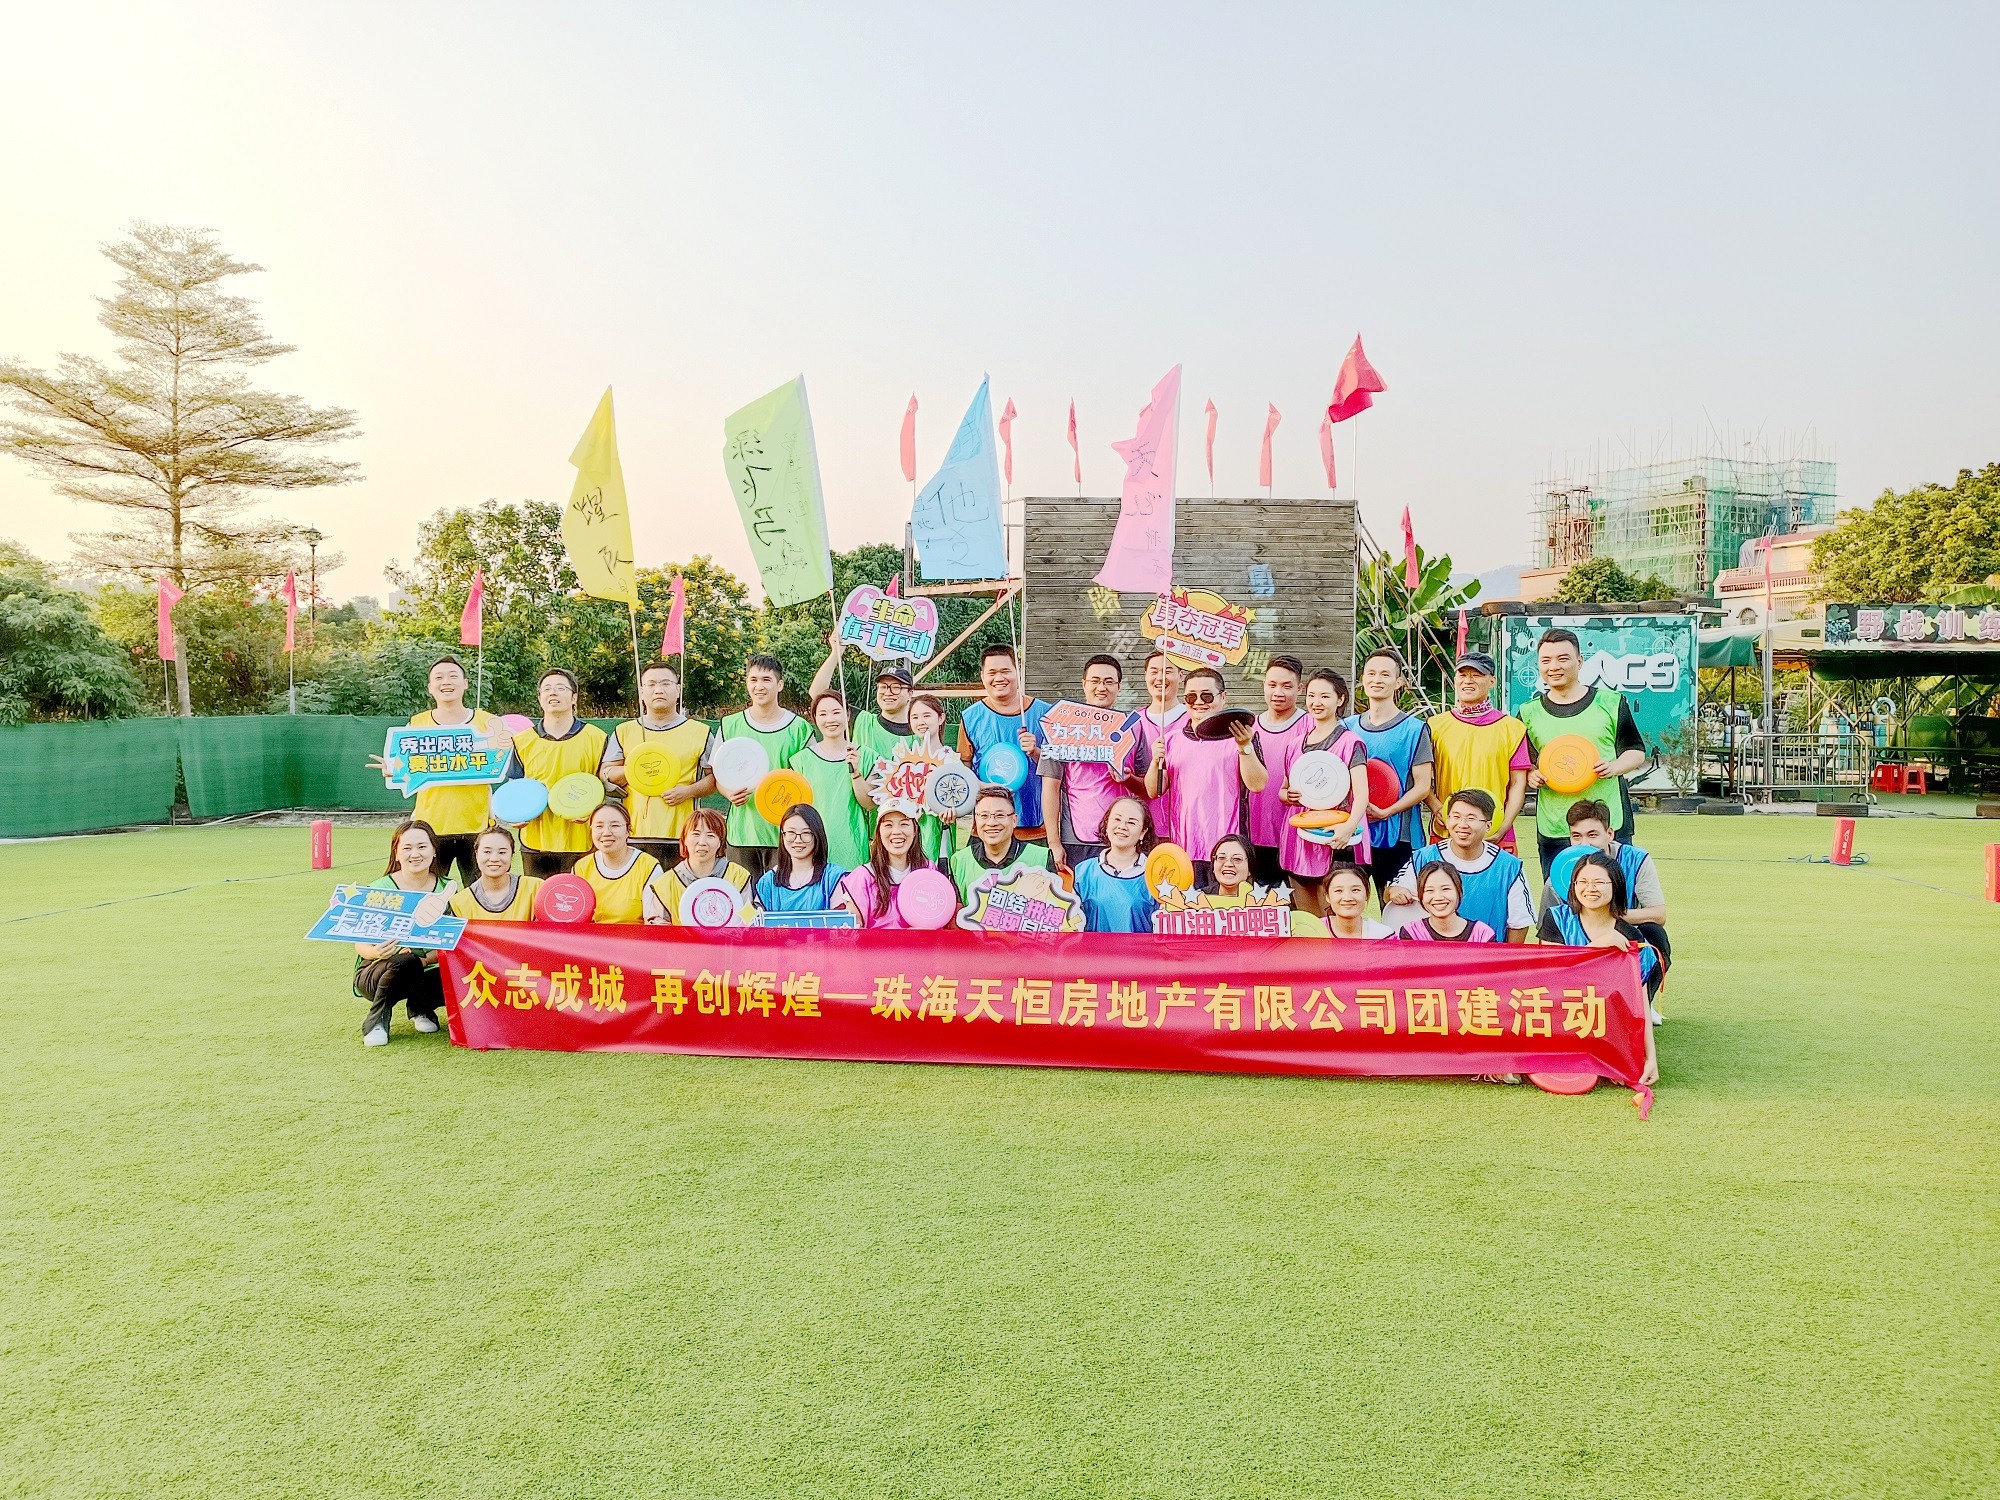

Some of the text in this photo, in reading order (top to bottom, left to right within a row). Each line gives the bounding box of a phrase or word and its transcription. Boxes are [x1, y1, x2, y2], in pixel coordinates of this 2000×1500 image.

[868, 599, 916, 627] 生命
[1156, 599, 1243, 645] 勇夺冠军
[1856, 609, 2000, 641] 野战训练
[841, 613, 932, 659] 在于运动
[1179, 643, 1203, 659] 加油
[1074, 709, 1091, 719] GO!
[1093, 712, 1114, 723] GO!
[1051, 722, 1106, 740] 为不凡
[400, 734, 474, 755] 秀出风采
[1041, 744, 1115, 762] 突破极限
[408, 752, 488, 774] 赛出水平
[363, 889, 405, 911] 燃烧
[988, 887, 1067, 928] 团结拼搏
[329, 908, 416, 941] 卡路里
[460, 960, 628, 1014] 众志成城
